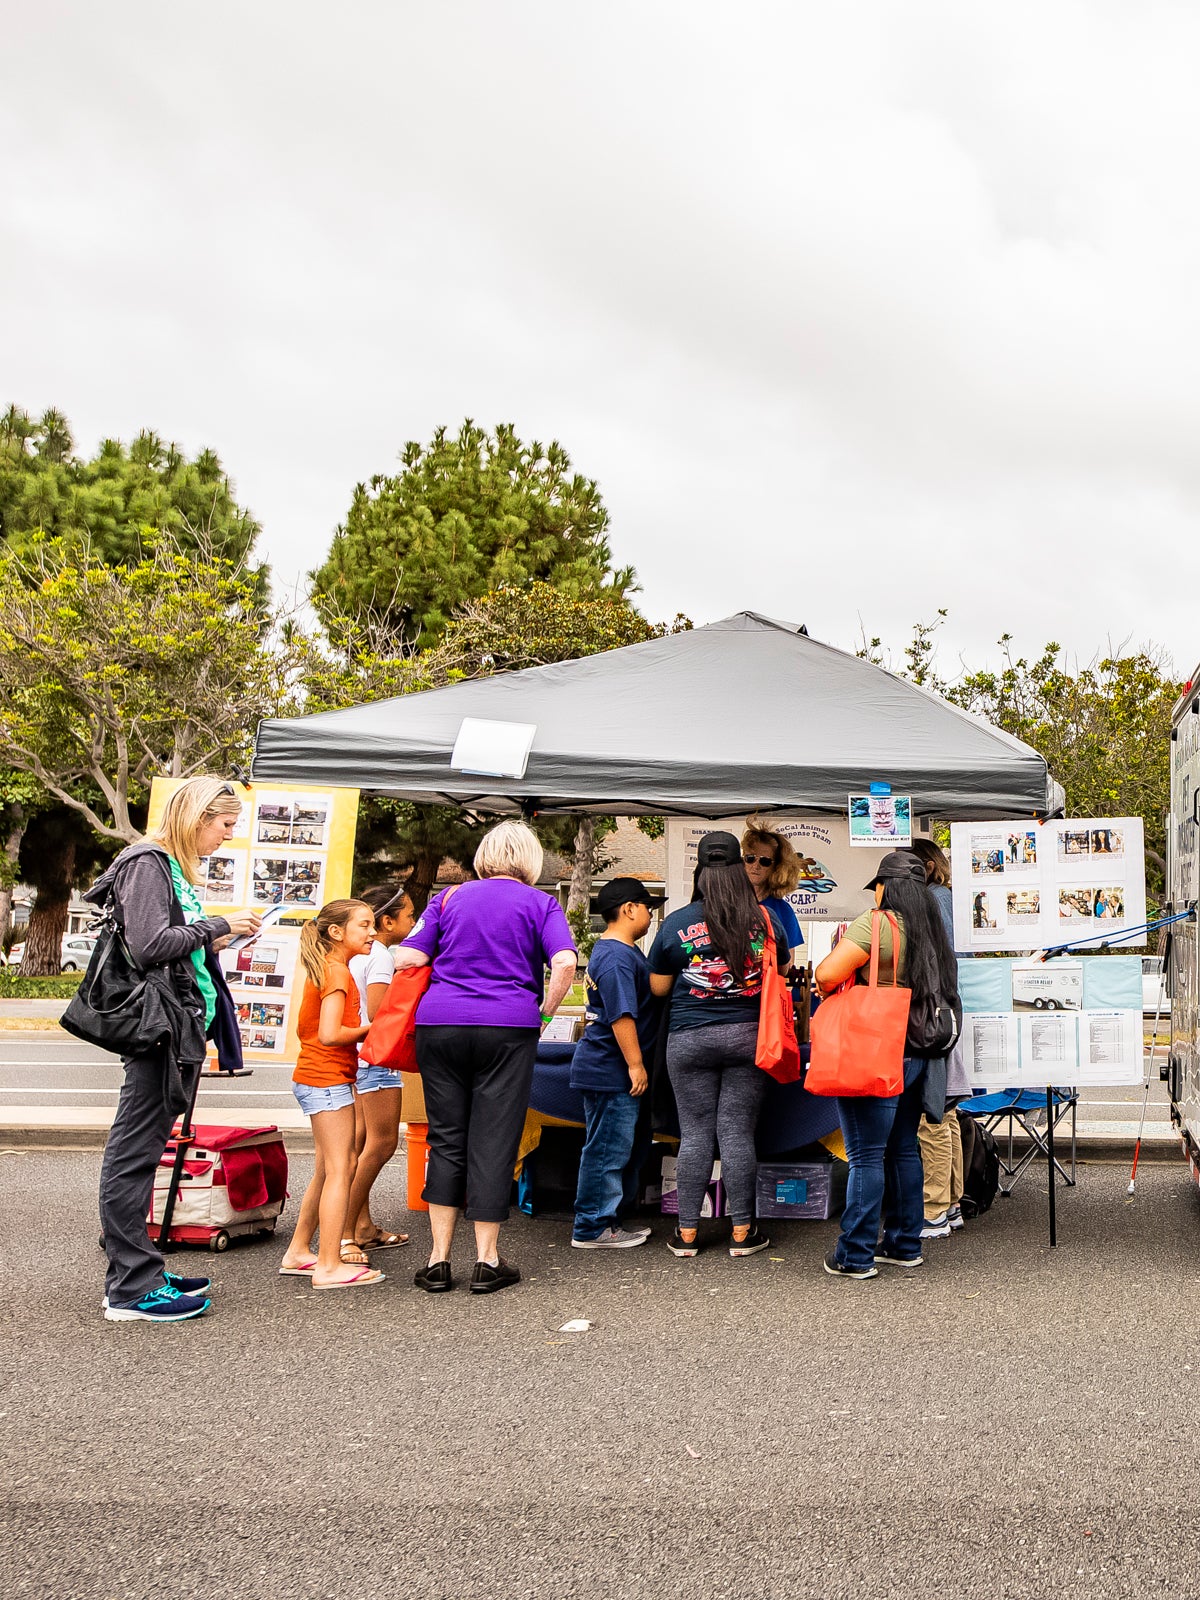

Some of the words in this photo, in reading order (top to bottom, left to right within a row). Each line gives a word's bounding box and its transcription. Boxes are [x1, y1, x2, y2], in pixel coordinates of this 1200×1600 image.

[800, 824, 829, 835] Animal
[783, 831, 811, 839] sponse
[812, 831, 832, 845] Team
[785, 894, 818, 905] SCART
[795, 906, 828, 915] .scart.us
[677, 921, 709, 943] LON
